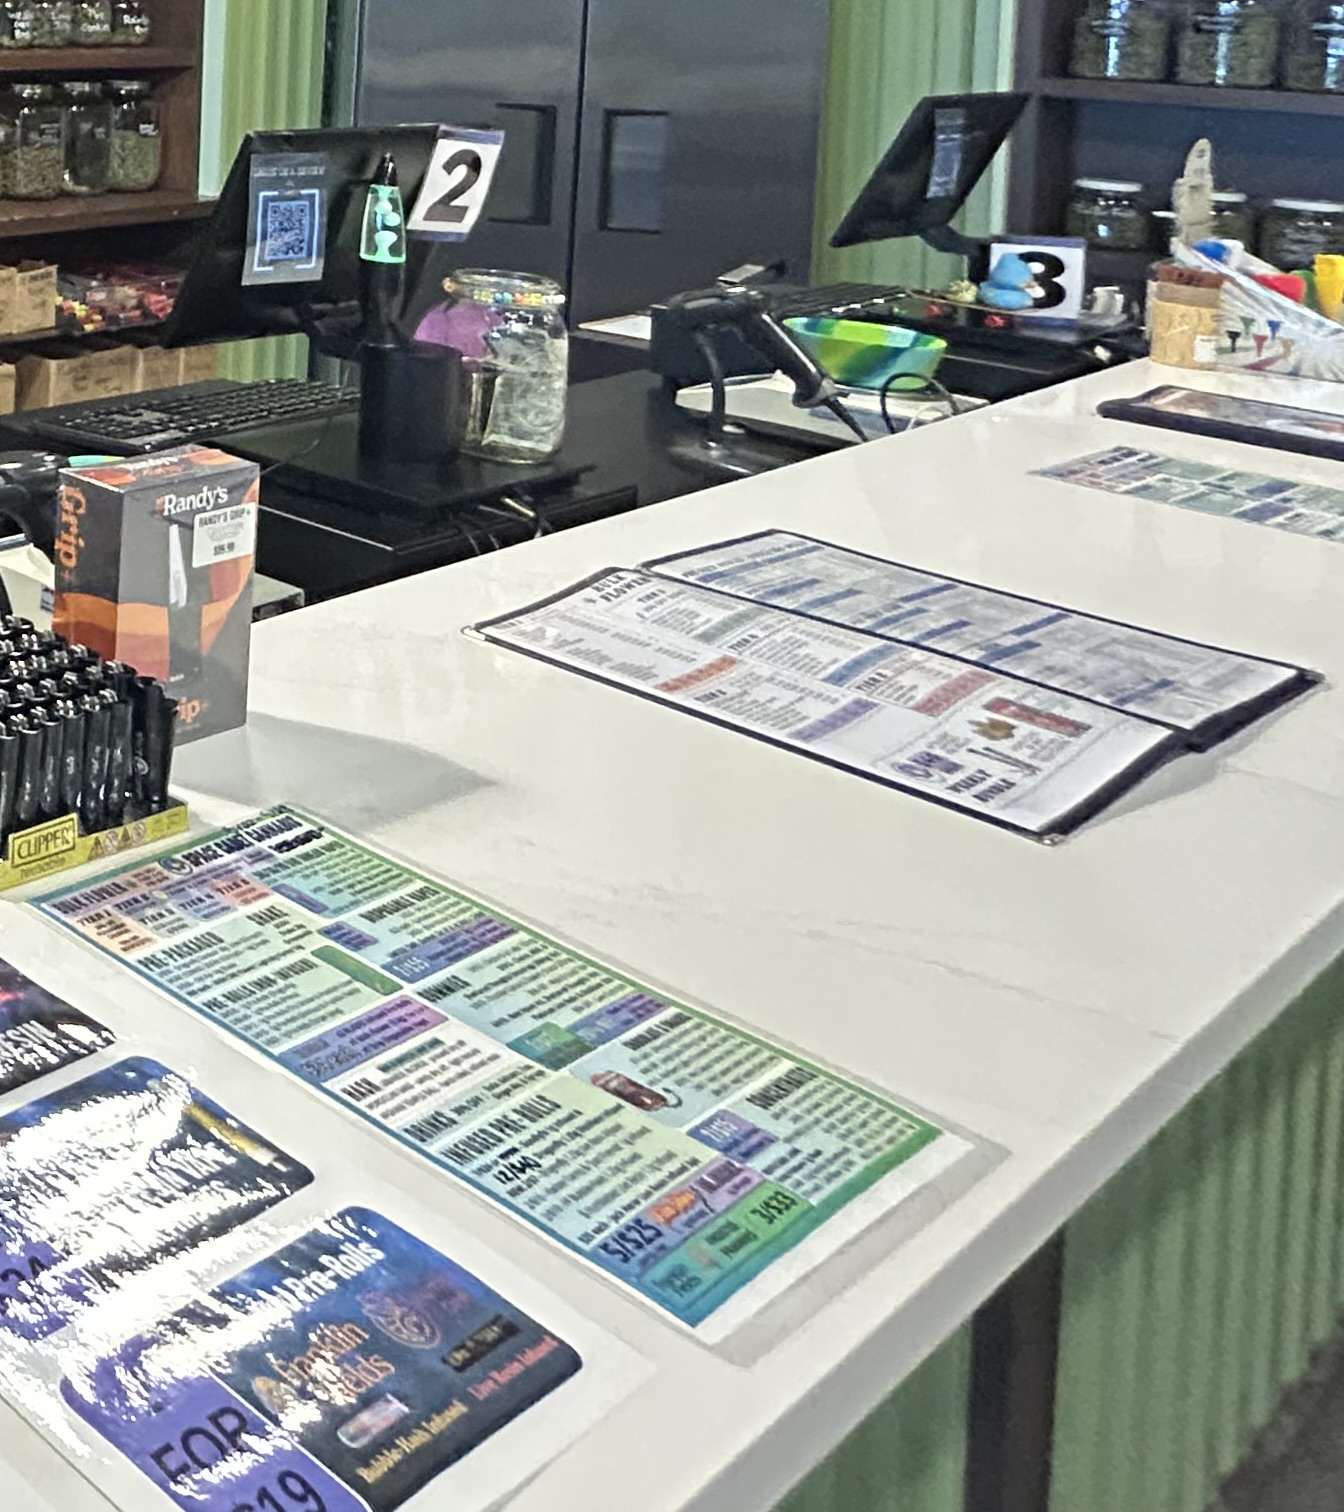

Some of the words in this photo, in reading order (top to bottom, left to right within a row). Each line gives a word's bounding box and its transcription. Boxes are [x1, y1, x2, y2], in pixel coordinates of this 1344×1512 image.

[422, 148, 483, 224] 2
[1014, 250, 1067, 310] 3
[162, 486, 229, 518] Randy's
[16, 827, 73, 861] CLIPPER
[283, 1239, 386, 1312] Pre-Rolls
[151, 1405, 250, 1482] FOR
[232, 1468, 329, 1512] 19
